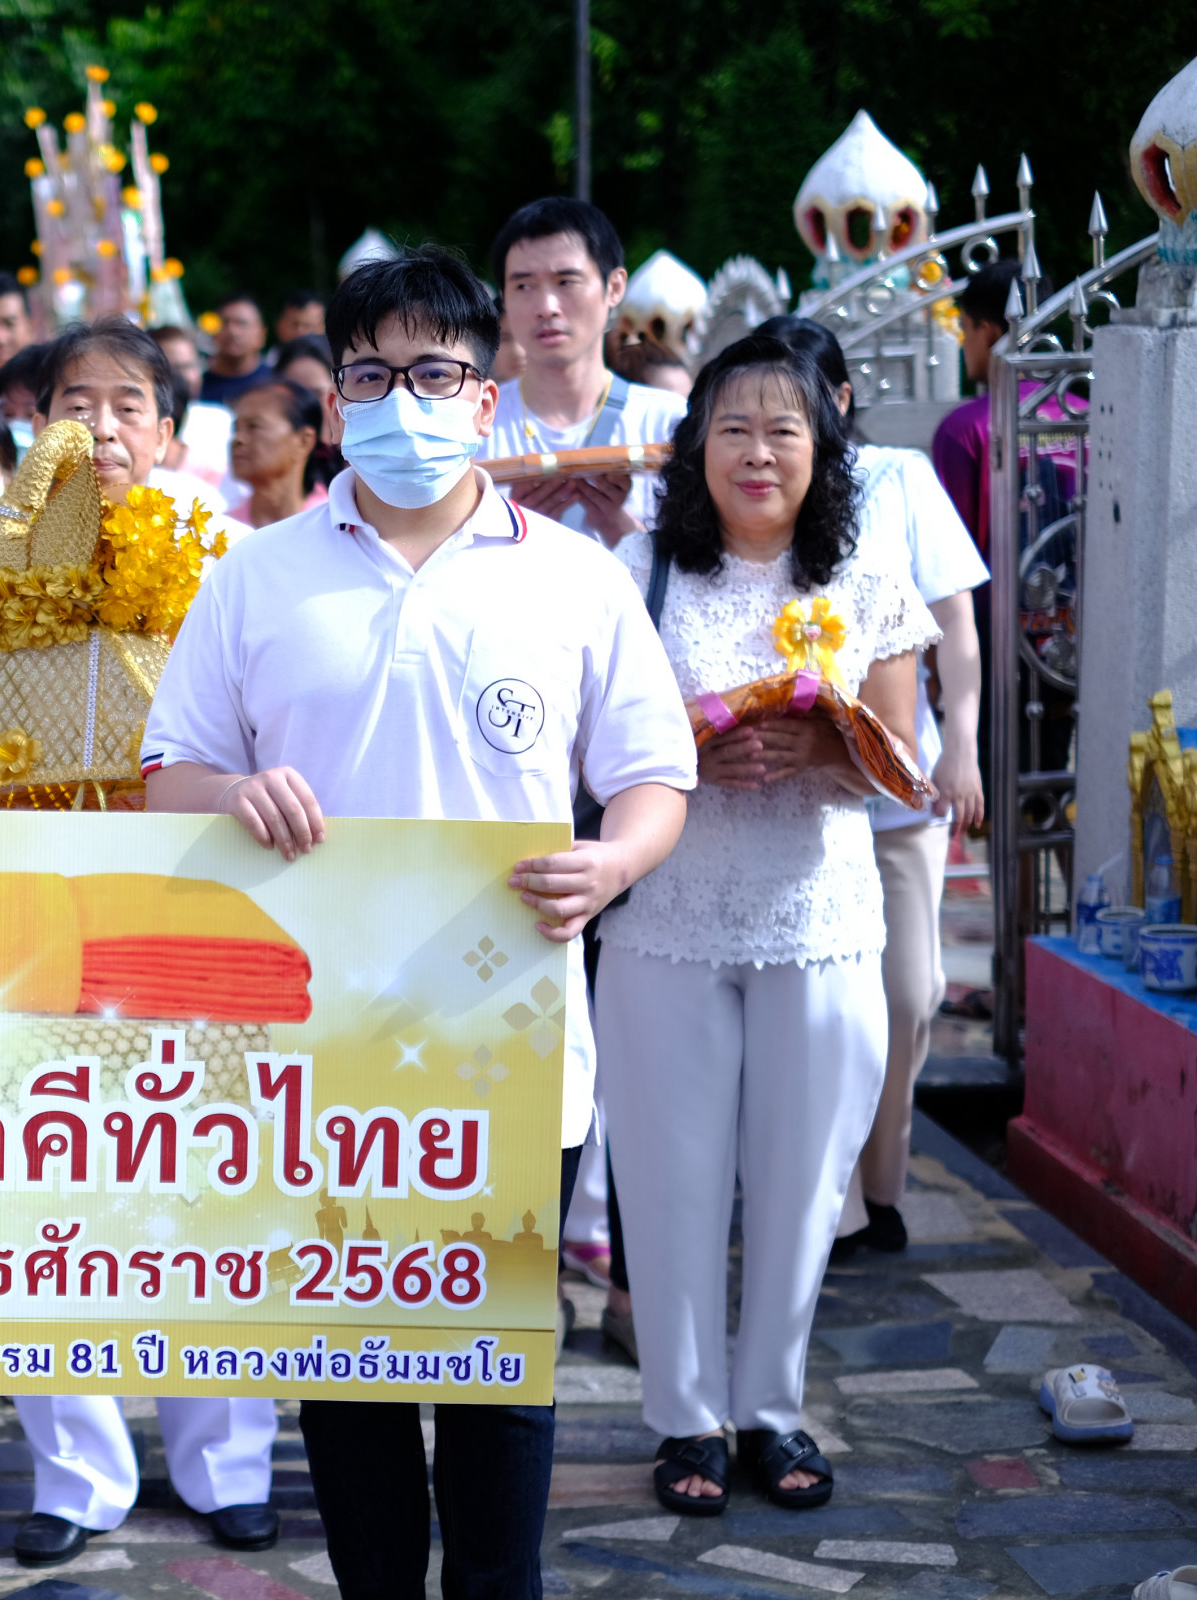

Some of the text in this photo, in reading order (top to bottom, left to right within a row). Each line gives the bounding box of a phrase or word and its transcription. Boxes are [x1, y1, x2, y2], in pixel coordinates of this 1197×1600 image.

[295, 1243, 482, 1304] 2568
[70, 1342, 119, 1375] 81
[137, 1334, 166, 1376] ปี
[184, 1338, 523, 1384] หลวงพ่อธัมมชโย
